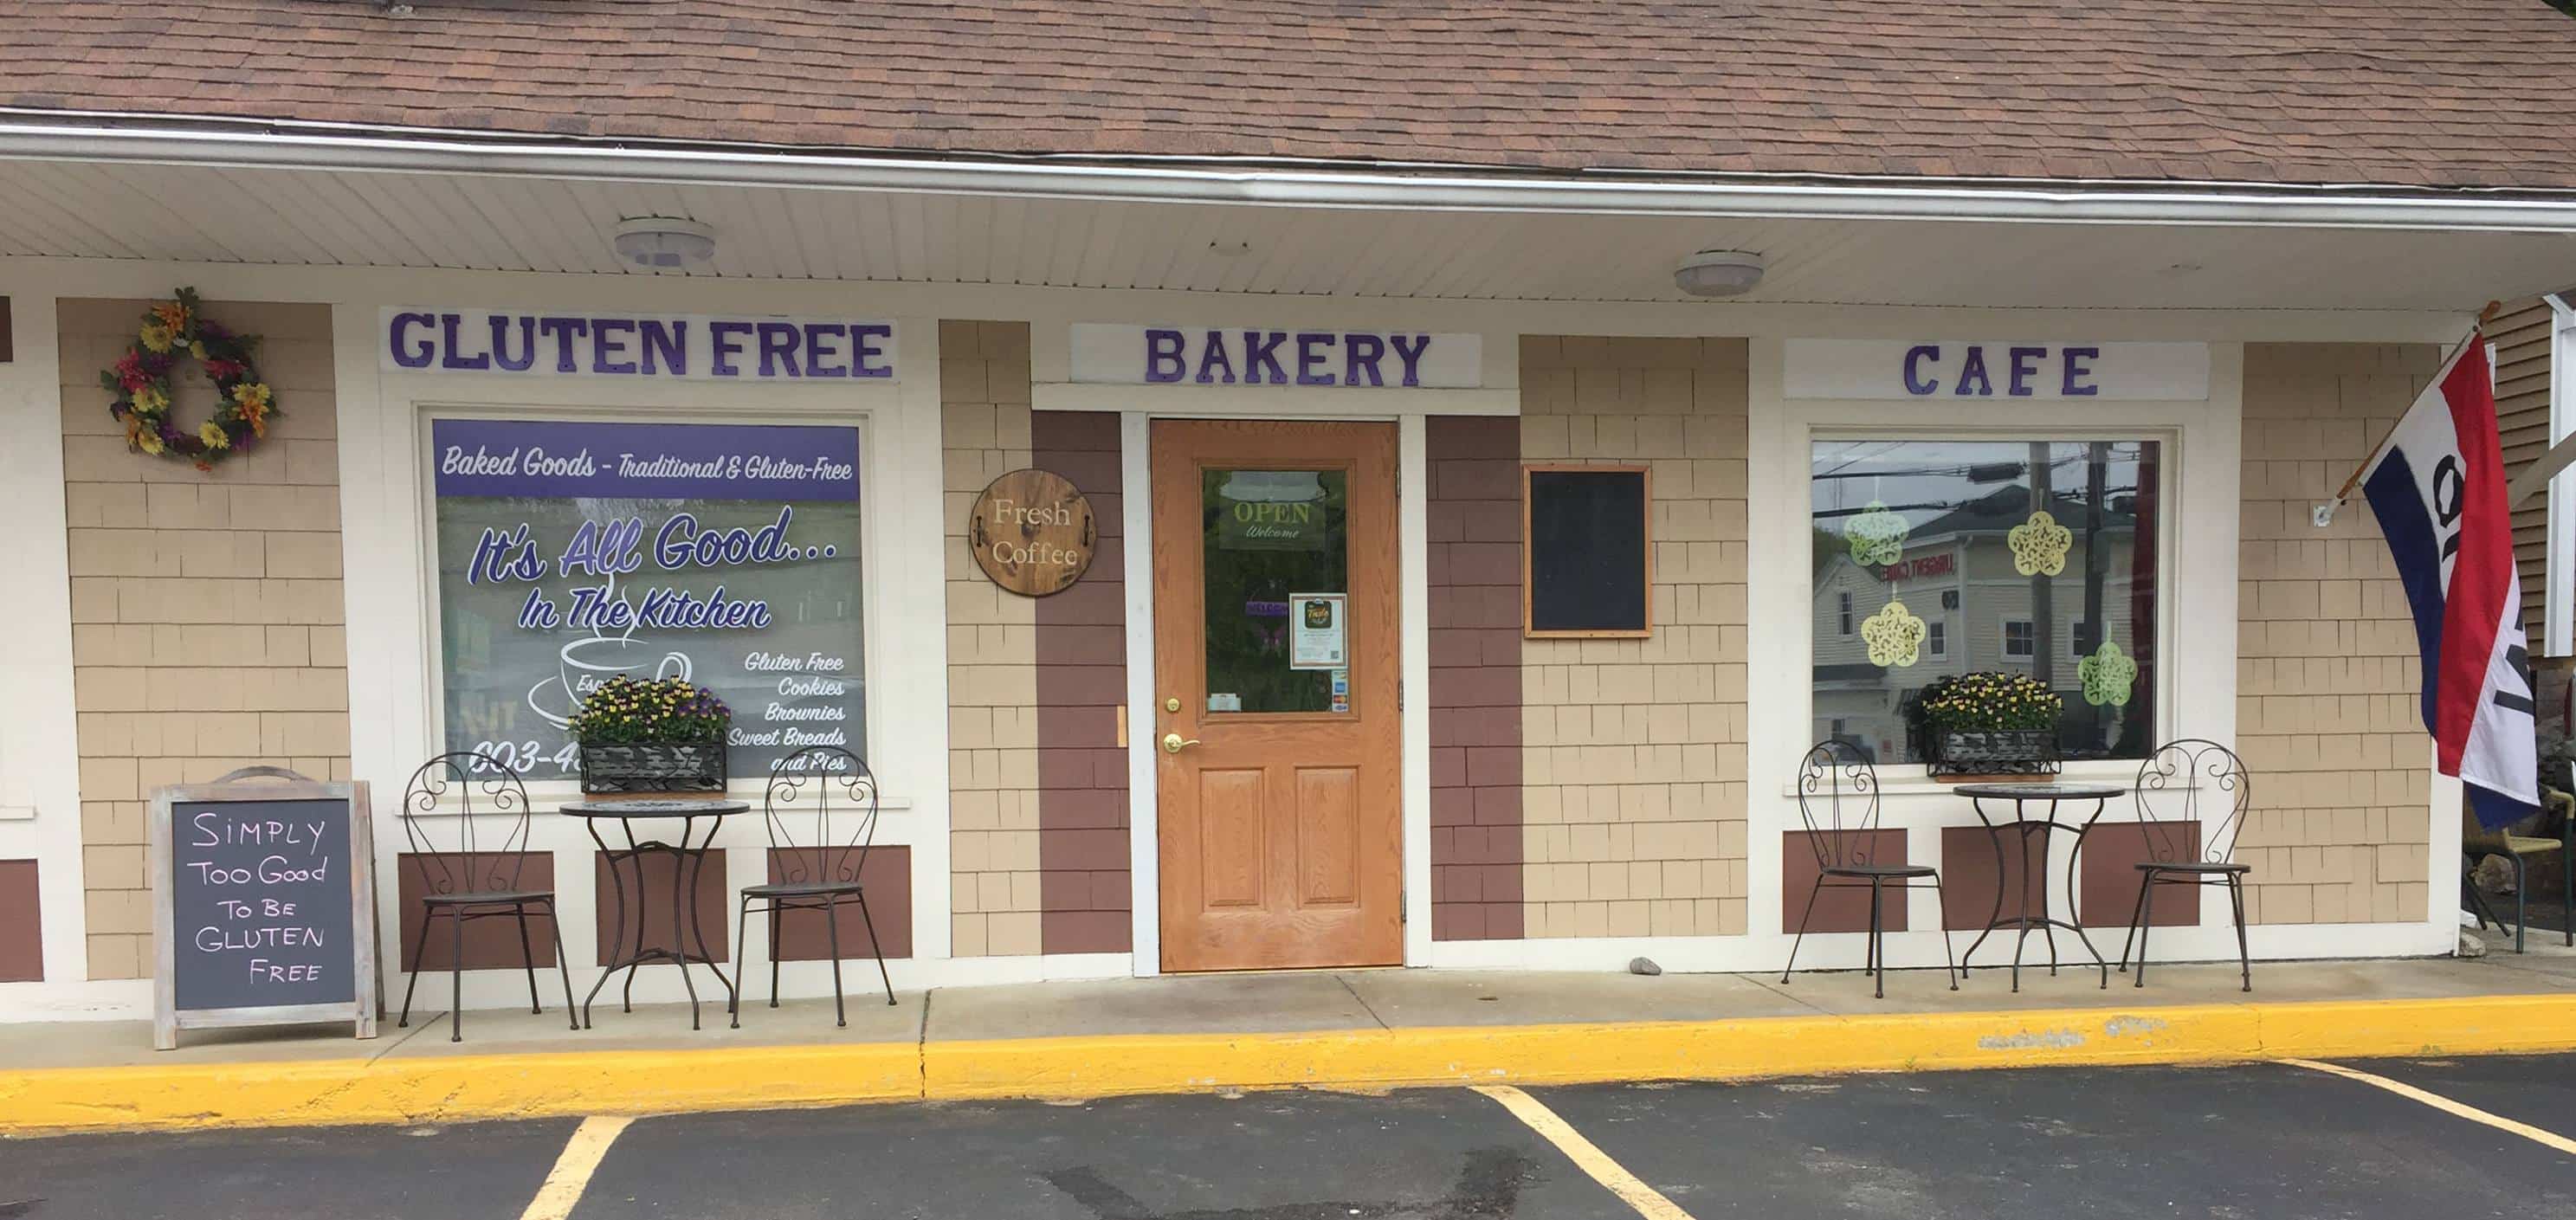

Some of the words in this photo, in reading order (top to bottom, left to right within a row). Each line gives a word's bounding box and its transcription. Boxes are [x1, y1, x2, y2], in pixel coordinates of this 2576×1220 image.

[389, 313, 688, 376] GLUTEN
[710, 321, 893, 378] FREE
[1145, 329, 1430, 387] BAKERY
[1904, 345, 2100, 396] CAFE
[442, 444, 520, 475] Baked
[523, 447, 597, 477] Goods
[618, 453, 725, 479] Traditional
[726, 455, 742, 480] &
[745, 455, 853, 481] Gluten-Free
[992, 499, 1071, 526] Fresh
[1234, 501, 1312, 524] OPEN
[1245, 526, 1300, 539] Welcome
[467, 522, 547, 586] It's
[558, 516, 644, 578] All
[653, 505, 837, 571] Good...
[992, 540, 1078, 565] Coffee
[519, 587, 560, 629] In
[567, 584, 634, 629] The
[636, 585, 772, 629] Kitchen
[745, 651, 803, 671] Gluten
[805, 652, 845, 671] Free
[778, 676, 846, 696] Cookies
[765, 702, 846, 721] Brownies
[726, 727, 780, 746] Sweet
[782, 727, 847, 746] Breads
[771, 752, 807, 771] and
[810, 752, 848, 771] Pies
[261, 898, 297, 918] BE
[195, 926, 325, 952] GLUTEN
[249, 959, 324, 985] FREE
